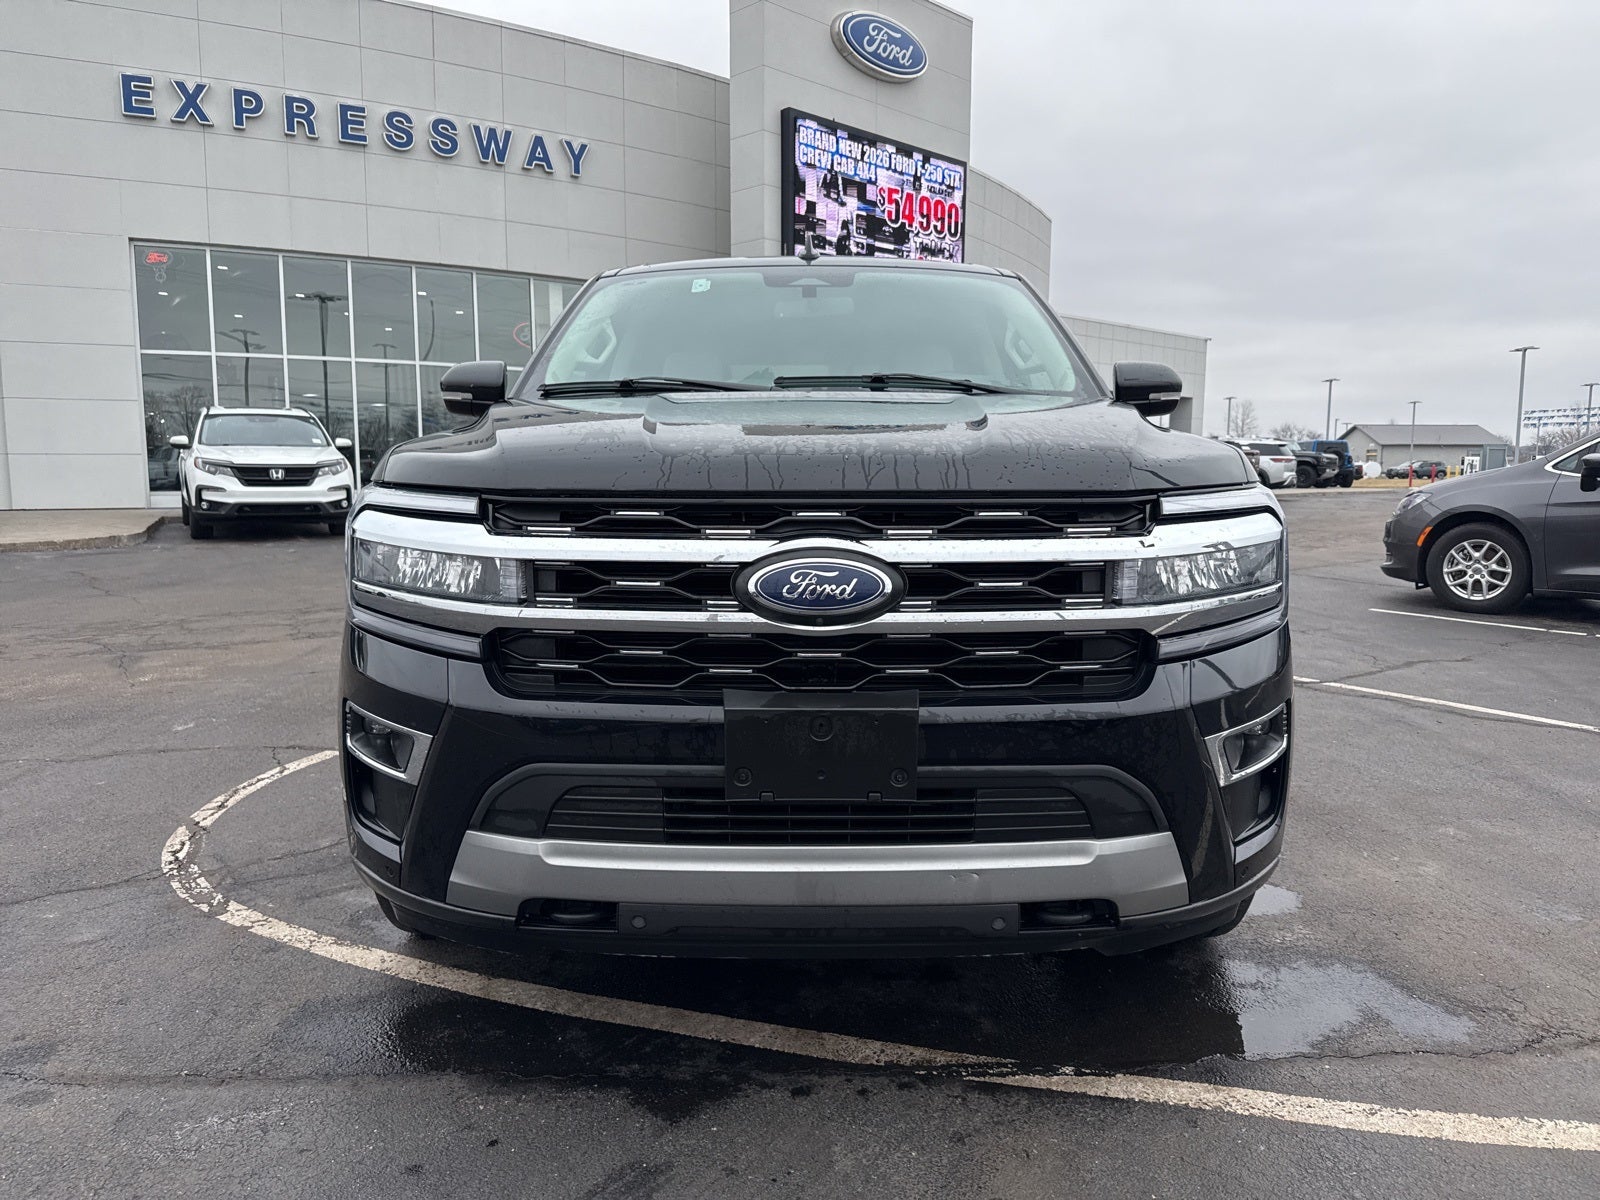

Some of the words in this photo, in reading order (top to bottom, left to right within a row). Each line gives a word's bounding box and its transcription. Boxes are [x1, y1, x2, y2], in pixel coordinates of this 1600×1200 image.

[863, 23, 913, 66] Ford
[119, 72, 589, 177] EXPRESSWAY
[799, 126, 837, 152] BRAND
[838, 138, 862, 161] NEW
[863, 144, 889, 167] 2026
[891, 152, 915, 175] FORD
[916, 160, 942, 184] F-250
[944, 169, 961, 188] STX
[799, 145, 832, 170] CREW
[833, 155, 854, 177] CAB
[878, 186, 960, 239] $54,990
[782, 569, 858, 599] Ford
